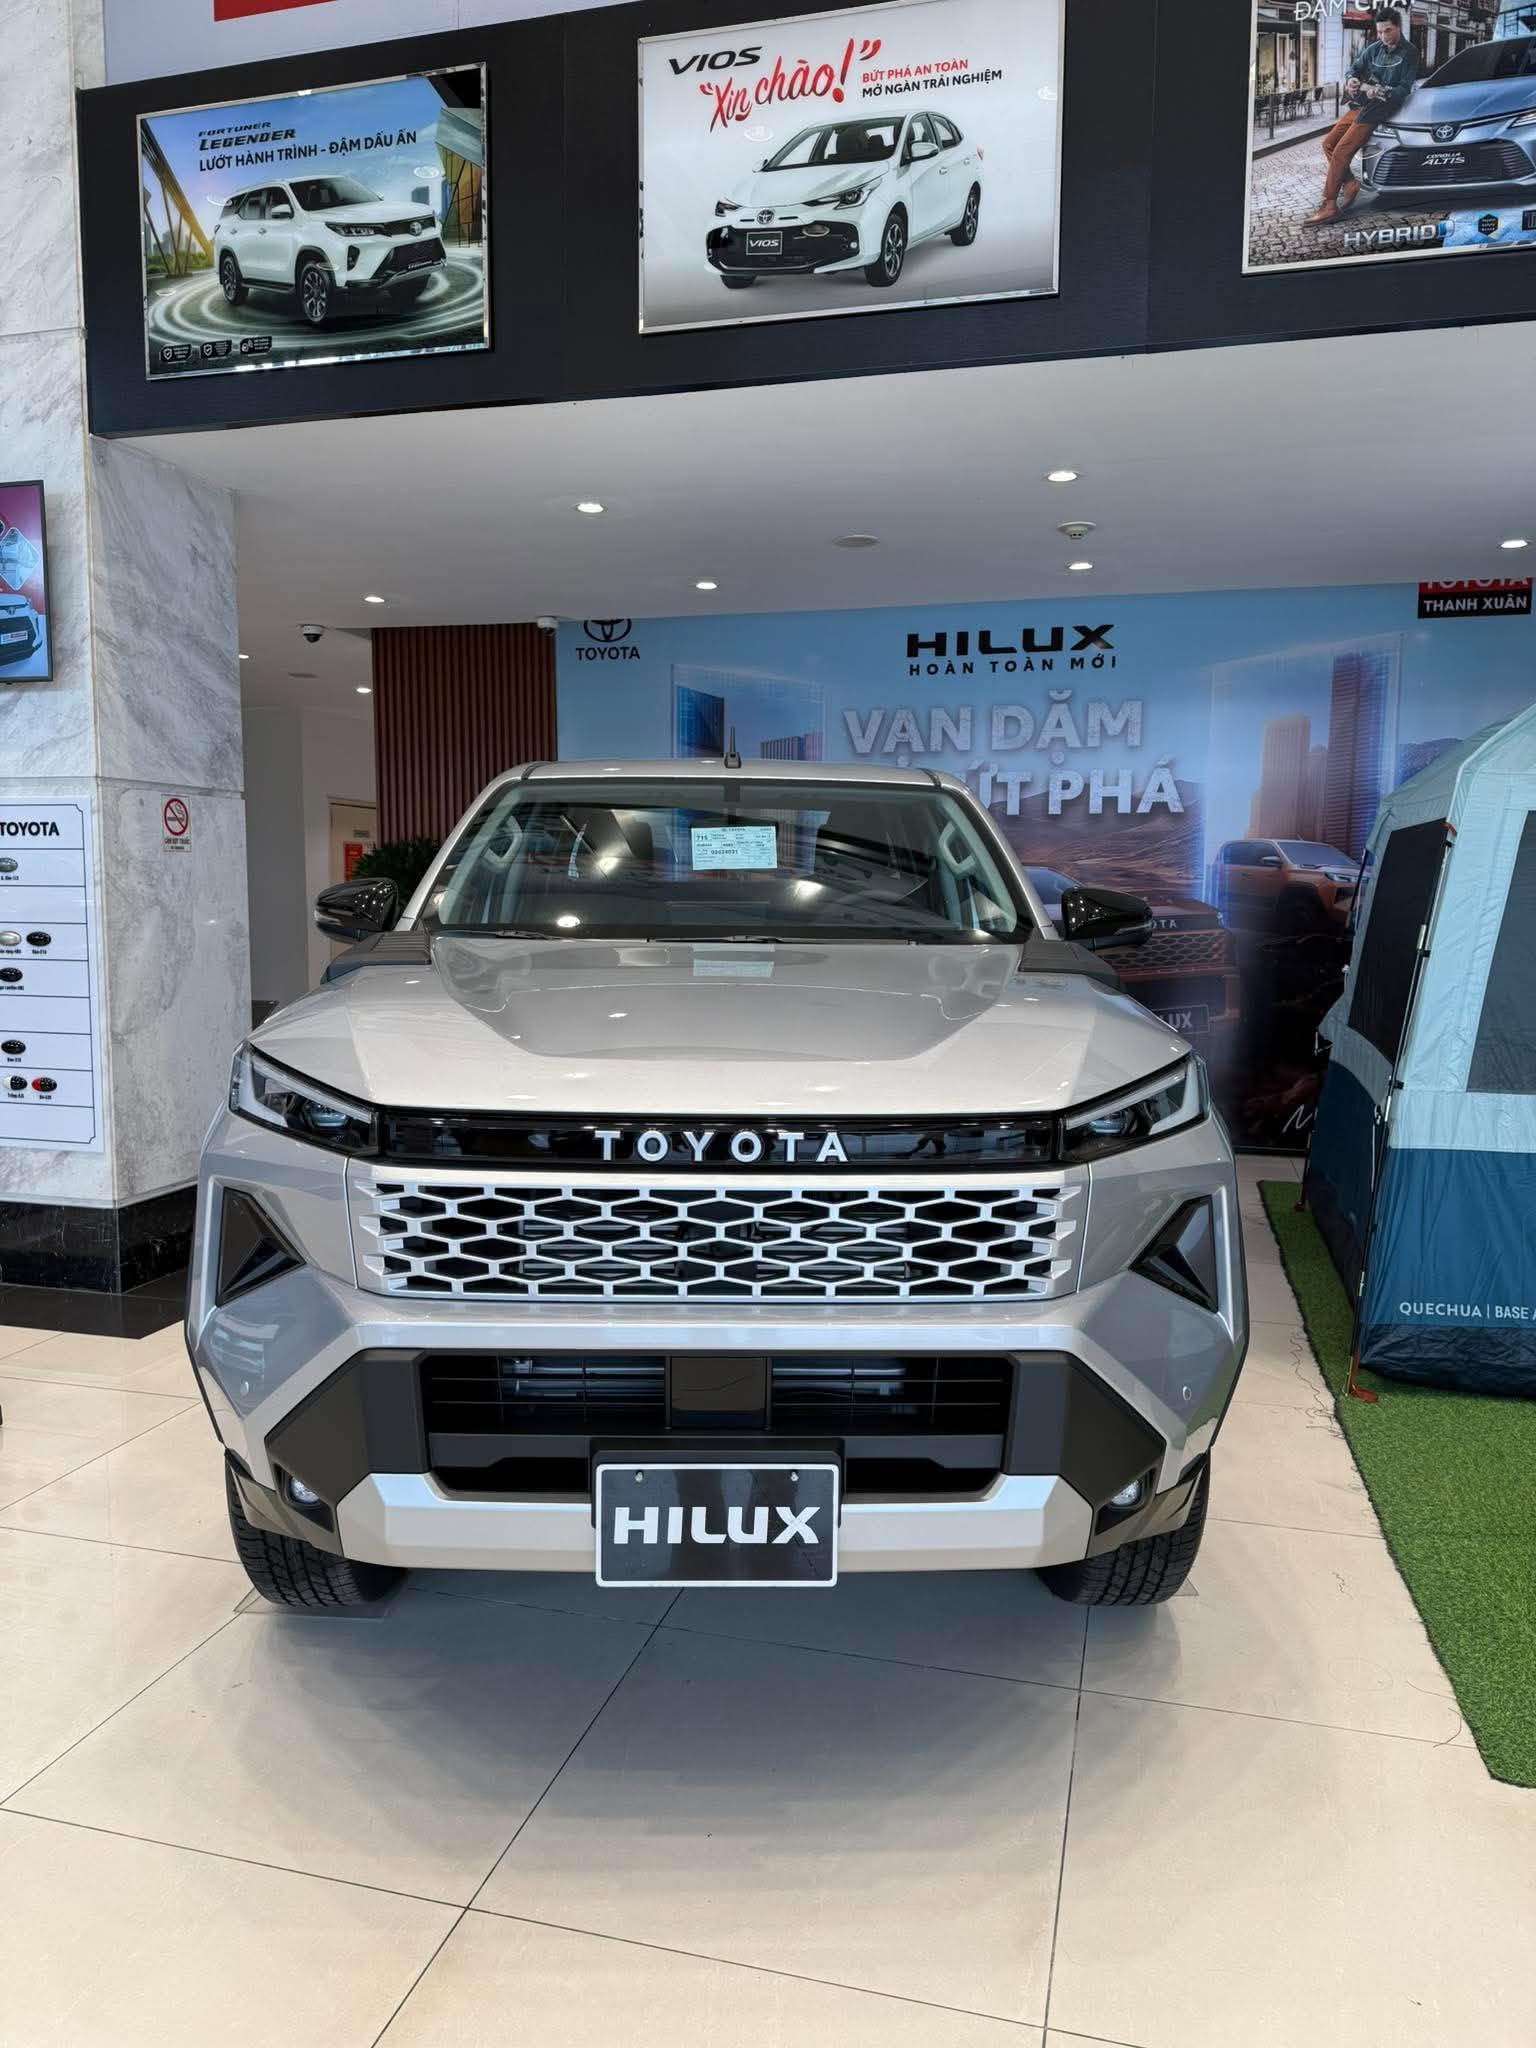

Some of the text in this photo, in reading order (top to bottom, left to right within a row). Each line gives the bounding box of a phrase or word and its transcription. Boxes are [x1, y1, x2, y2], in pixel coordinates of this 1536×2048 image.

[669, 46, 763, 75] VIOS
[862, 58, 969, 83] BỨT PHÁ AN TOÀN
[862, 69, 1003, 98] MỞ NGÀN TRẢI NGHIỆM
[198, 121, 272, 137] FORTUNER
[199, 128, 297, 151] LEGENDER
[199, 153, 233, 172] LƯỚT
[236, 148, 274, 167] HÀNH
[278, 143, 318, 161] TRÌNH
[329, 136, 361, 156] ĐẬM
[364, 130, 394, 148] DẤU
[396, 127, 417, 145] ẤN
[1420, 156, 1465, 166] ALTIS
[750, 239, 779, 247] VIOS
[1343, 223, 1437, 248] HYBRID
[1423, 598, 1478, 612] THANH
[575, 646, 641, 660] TOYOTA
[906, 624, 1115, 658] HILUX
[909, 652, 1117, 676] HOÀN TOÀN MỚI
[843, 688, 1144, 768] VẠN DẶM
[1048, 753, 1185, 815] PHÁ
[0, 821, 60, 836] TOYOTA
[594, 1130, 849, 1163] TOYOTA
[1399, 1301, 1483, 1318] QUECHUA
[1495, 1305, 1529, 1320] BASE
[613, 1506, 821, 1544] HILUX
